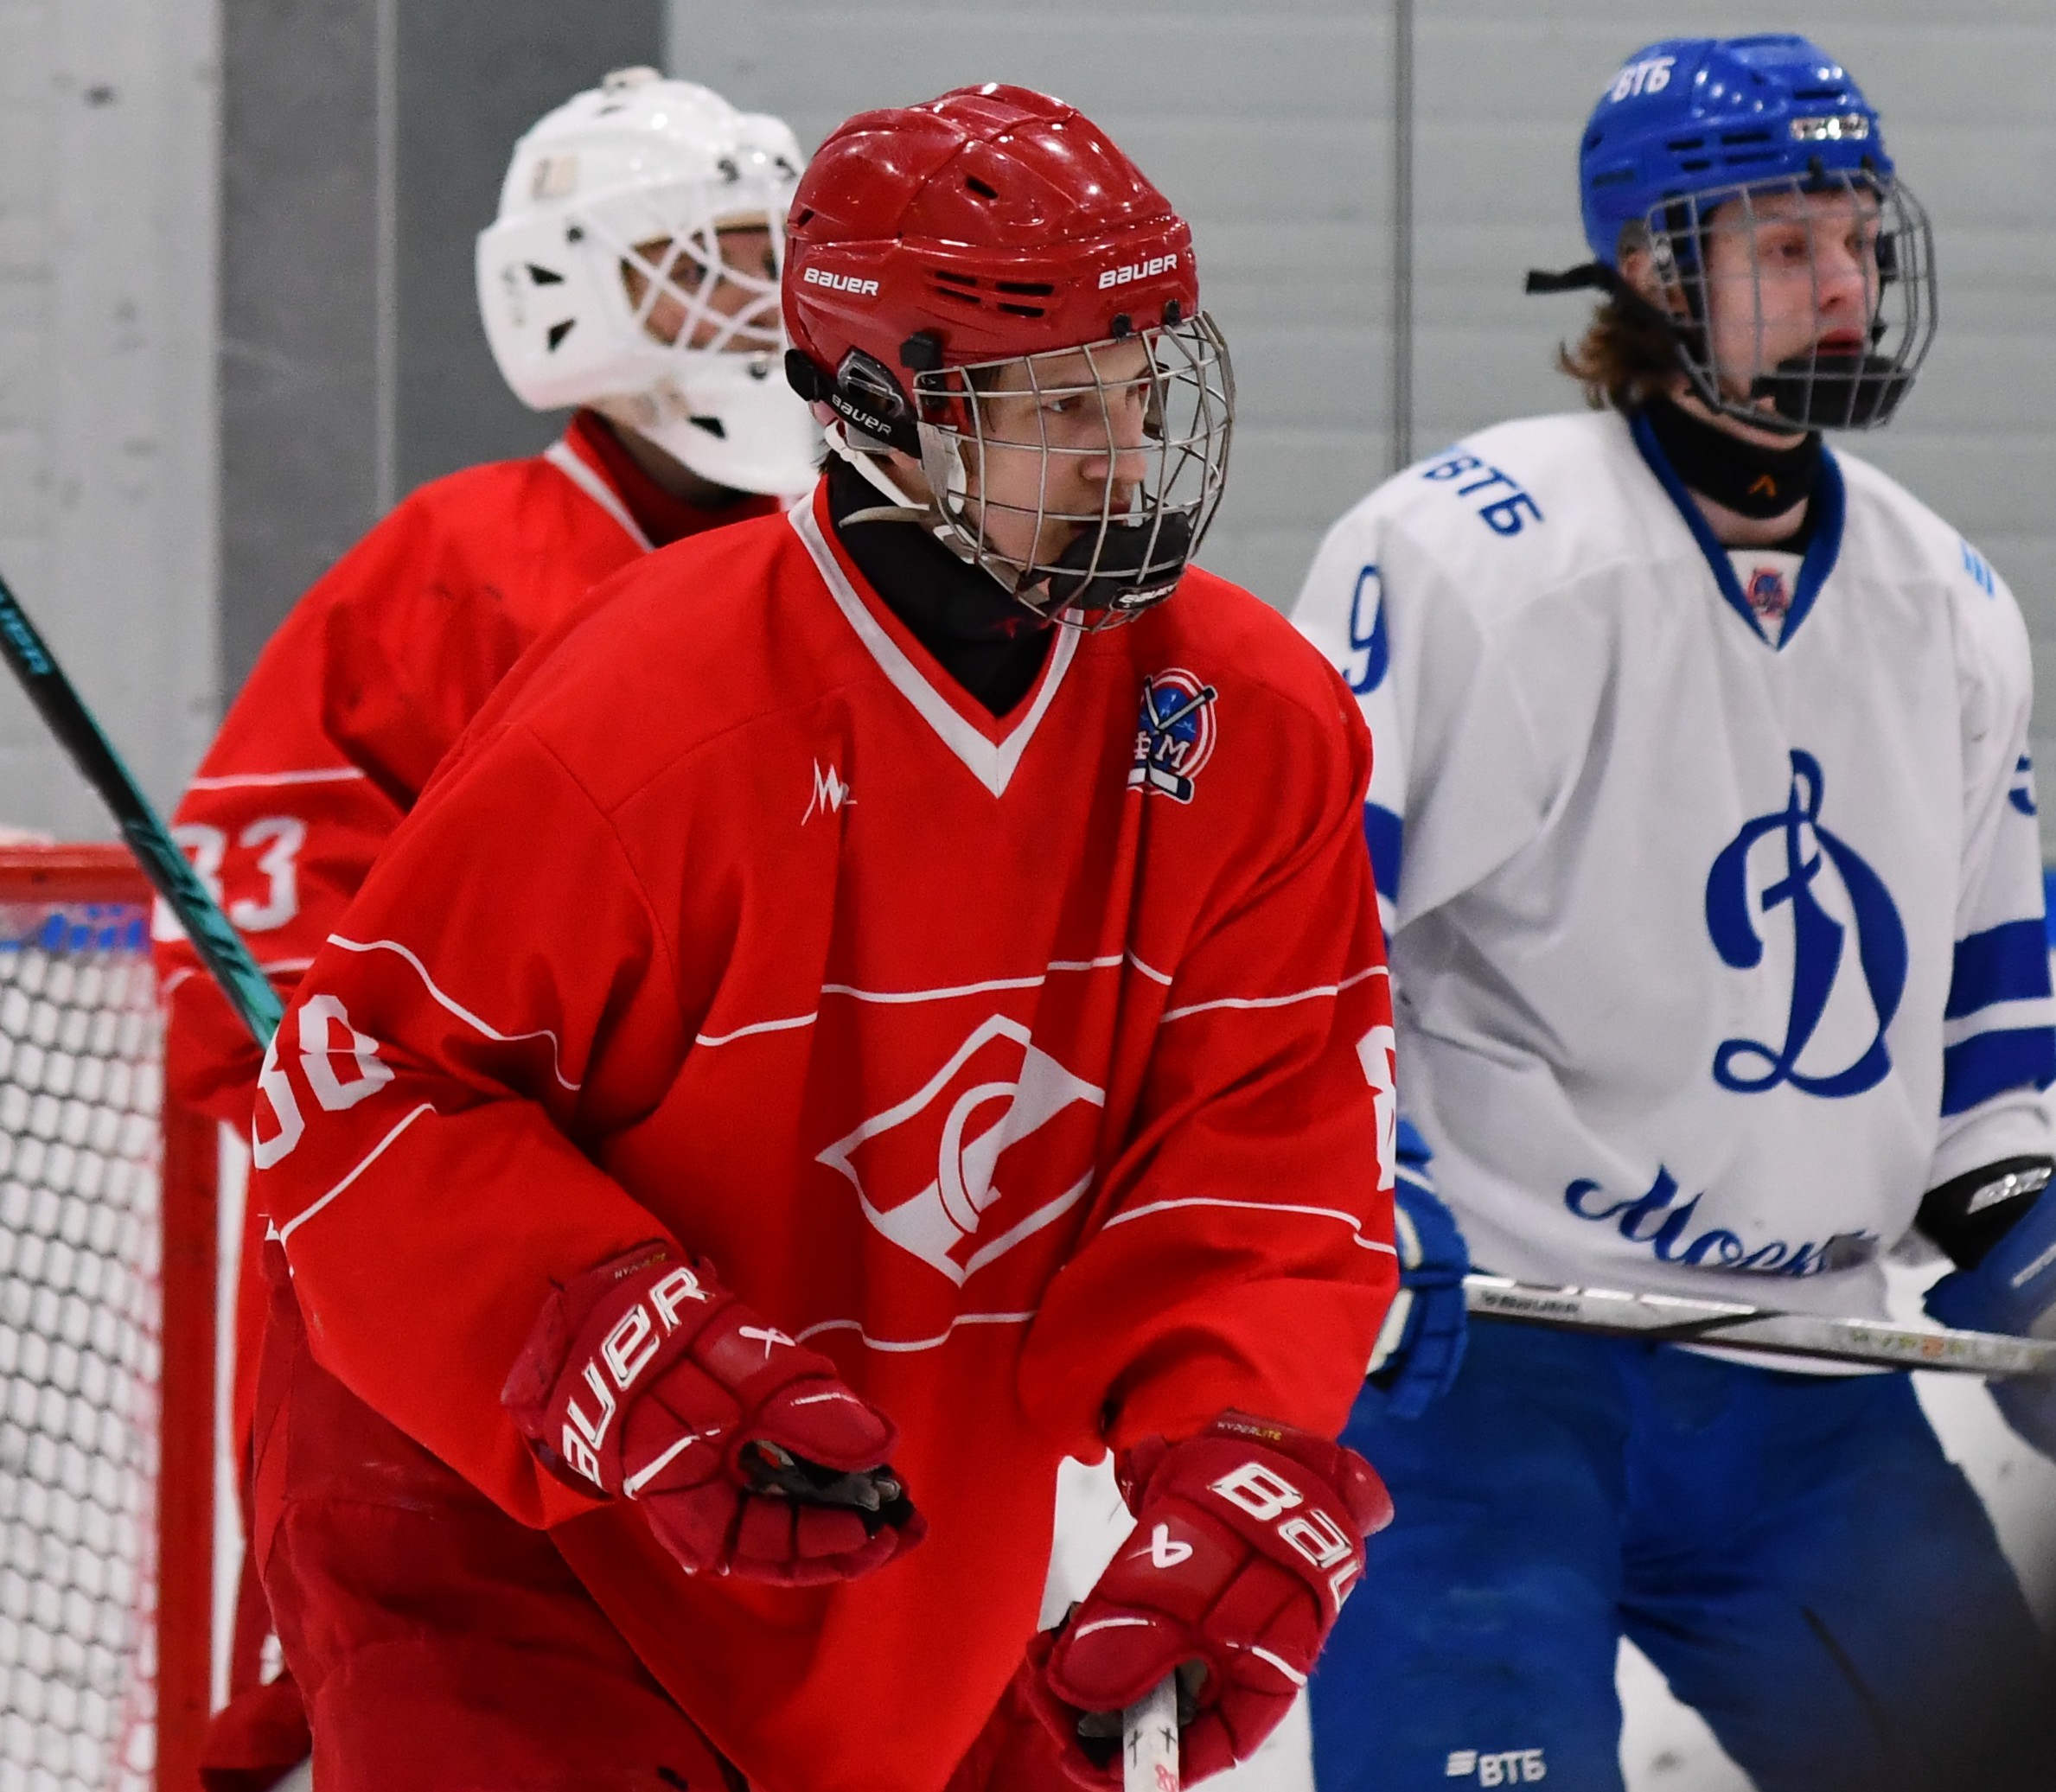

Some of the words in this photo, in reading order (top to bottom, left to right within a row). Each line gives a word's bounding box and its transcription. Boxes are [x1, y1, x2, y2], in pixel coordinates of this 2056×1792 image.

[803, 266, 879, 297] BAUER
[1097, 253, 1178, 290] BAUER
[831, 392, 893, 437] BAUER
[563, 1267, 716, 1490] AUER
